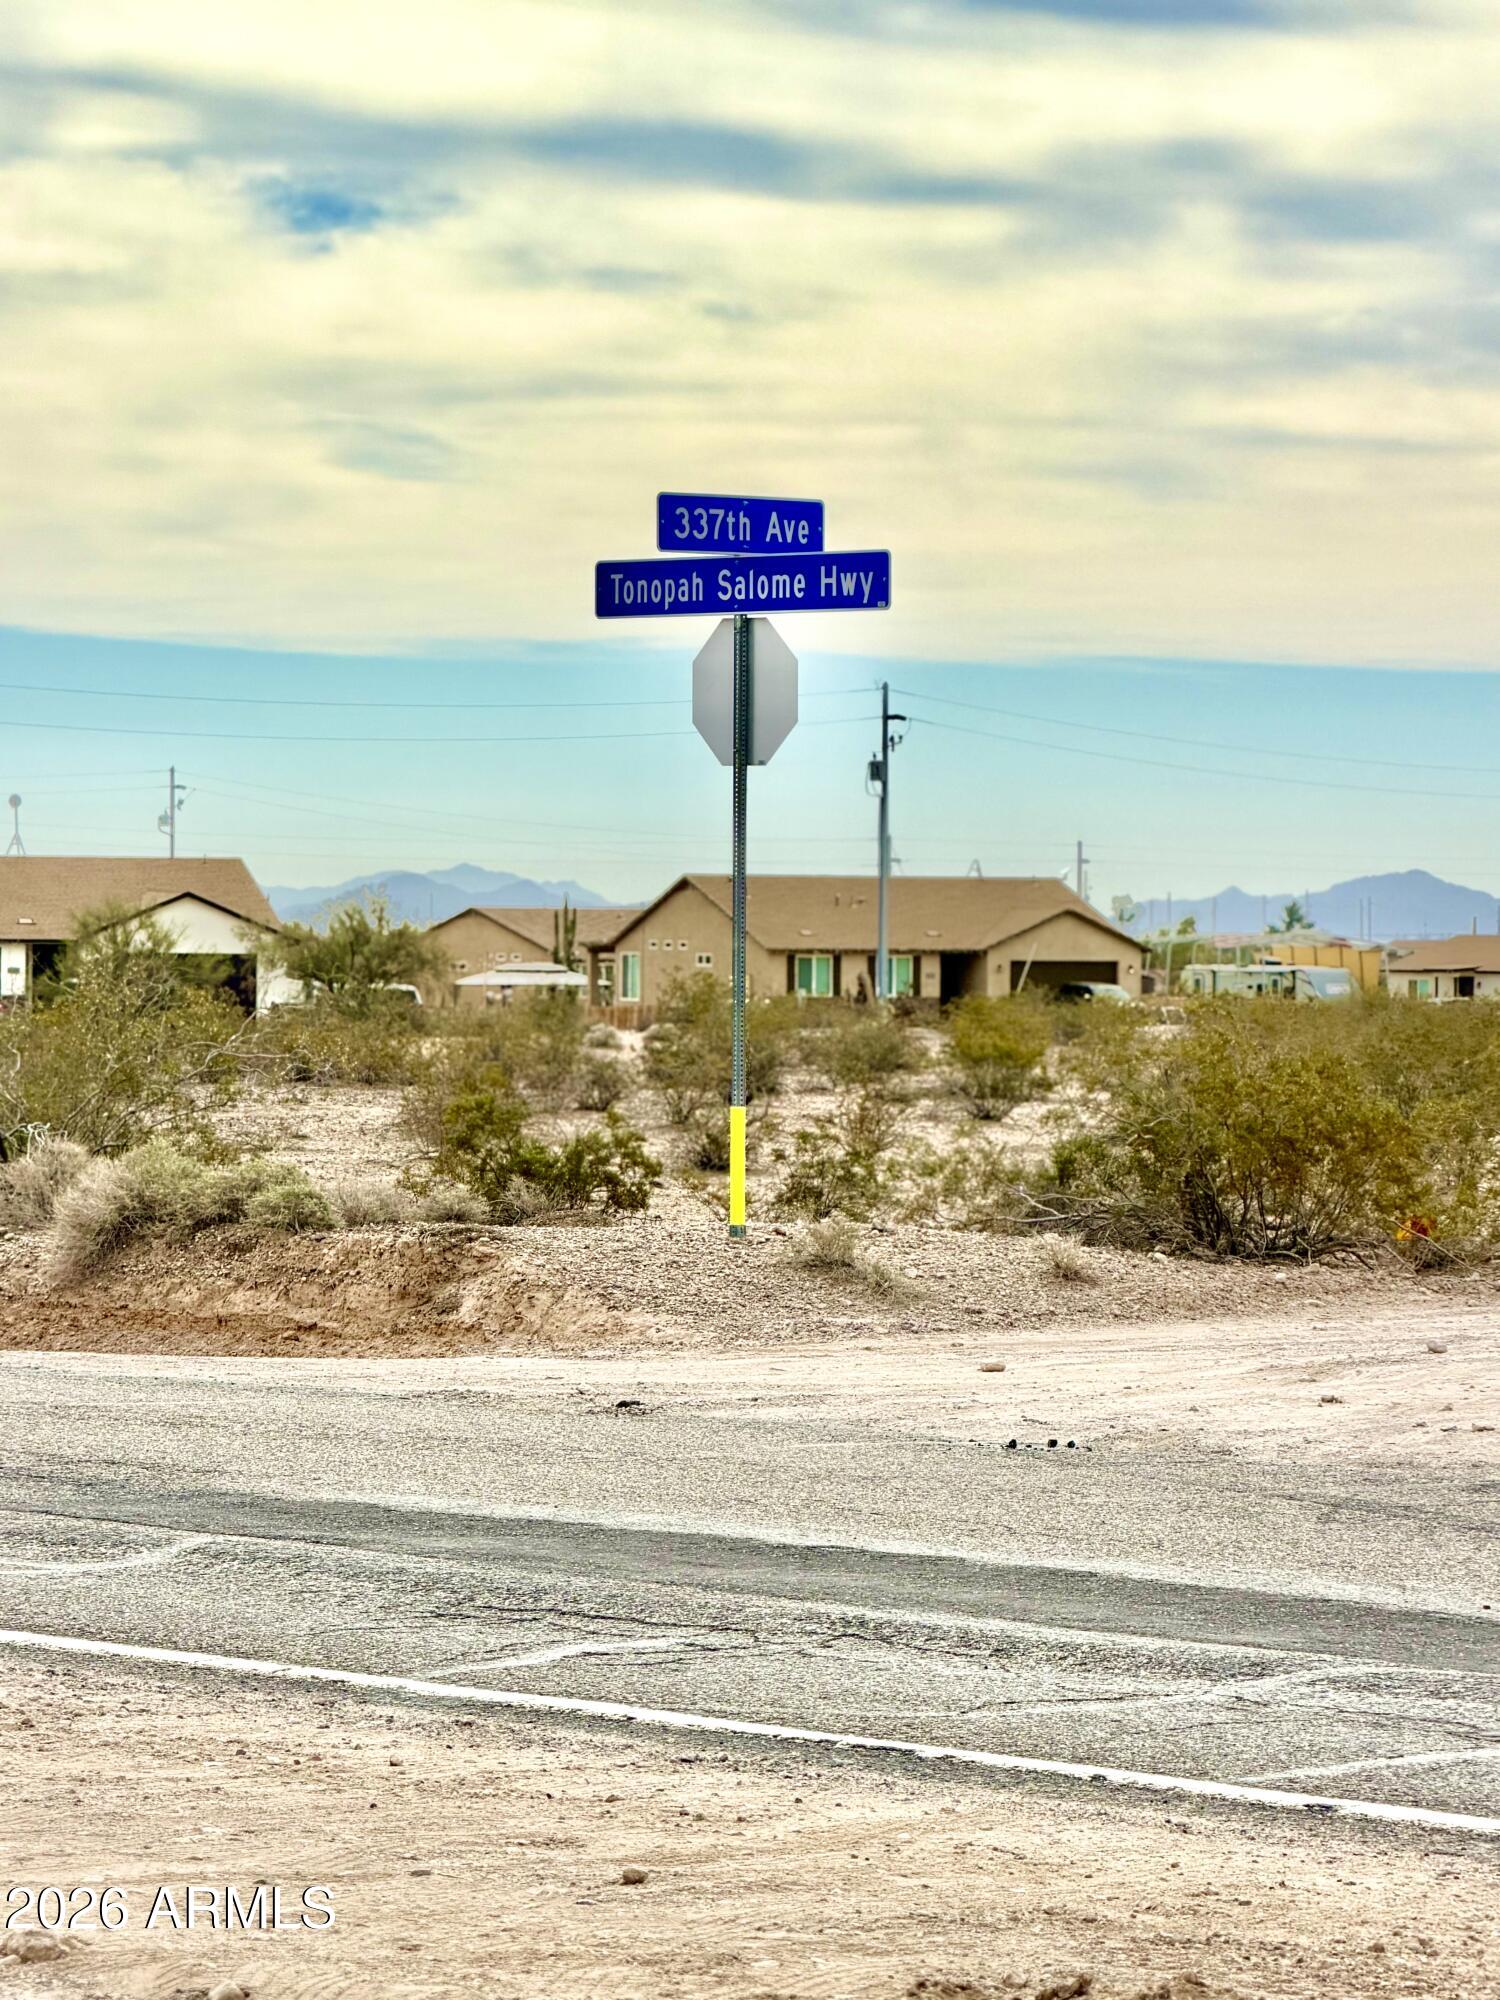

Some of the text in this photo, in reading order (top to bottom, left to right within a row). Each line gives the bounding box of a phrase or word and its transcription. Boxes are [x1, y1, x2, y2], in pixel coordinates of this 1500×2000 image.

[674, 506, 809, 544] 337th Ave
[610, 565, 874, 610] Tonopah Salome Hwy
